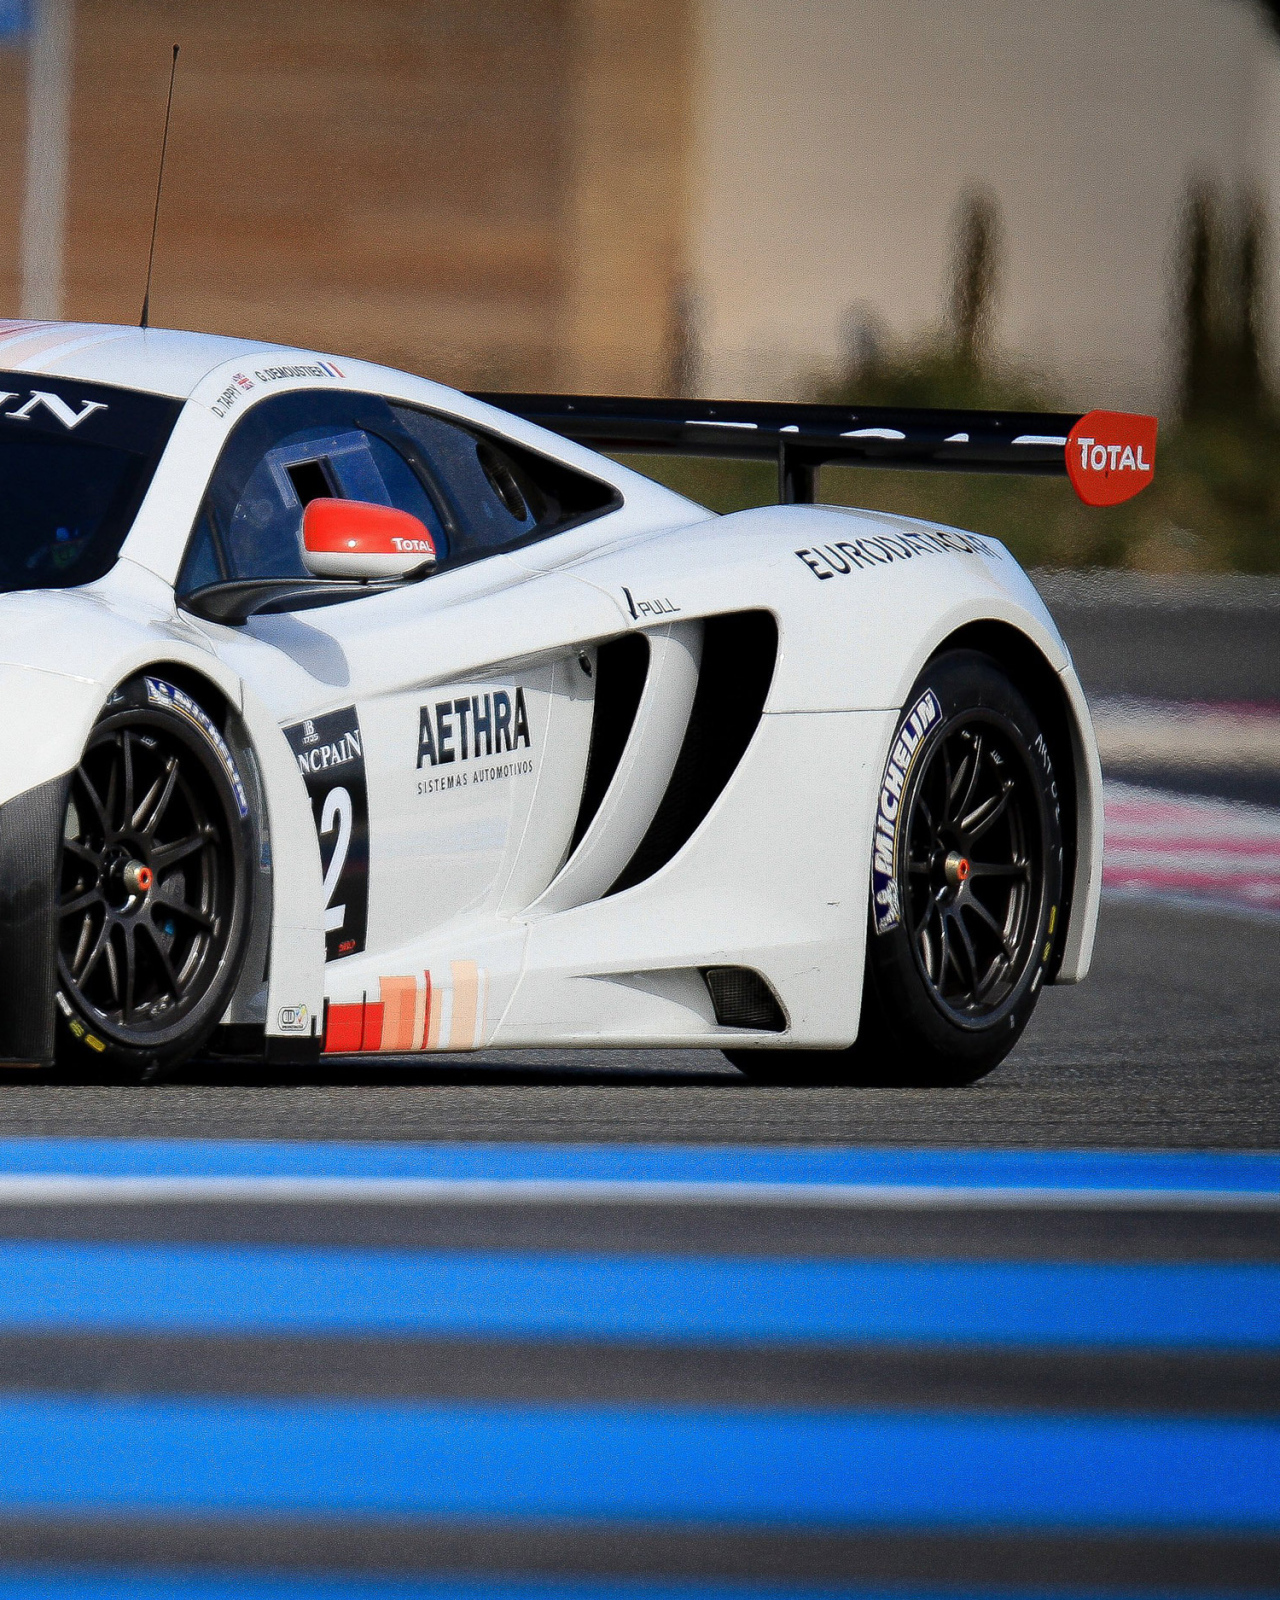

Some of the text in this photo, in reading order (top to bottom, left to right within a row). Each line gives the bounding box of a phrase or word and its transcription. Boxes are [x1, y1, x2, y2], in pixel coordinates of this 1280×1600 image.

[211, 383, 242, 419] D. TAPPY
[1076, 436, 1151, 472] TOTAL
[391, 536, 434, 552] TOTAL
[794, 531, 1003, 581] EURODATACAR
[636, 597, 681, 616] PULL
[416, 685, 532, 769] AETHRA
[417, 759, 534, 795] SISTEMAS AUTOMOTIVOS
[874, 693, 939, 875] MICHELIN
[320, 785, 353, 932] 2
